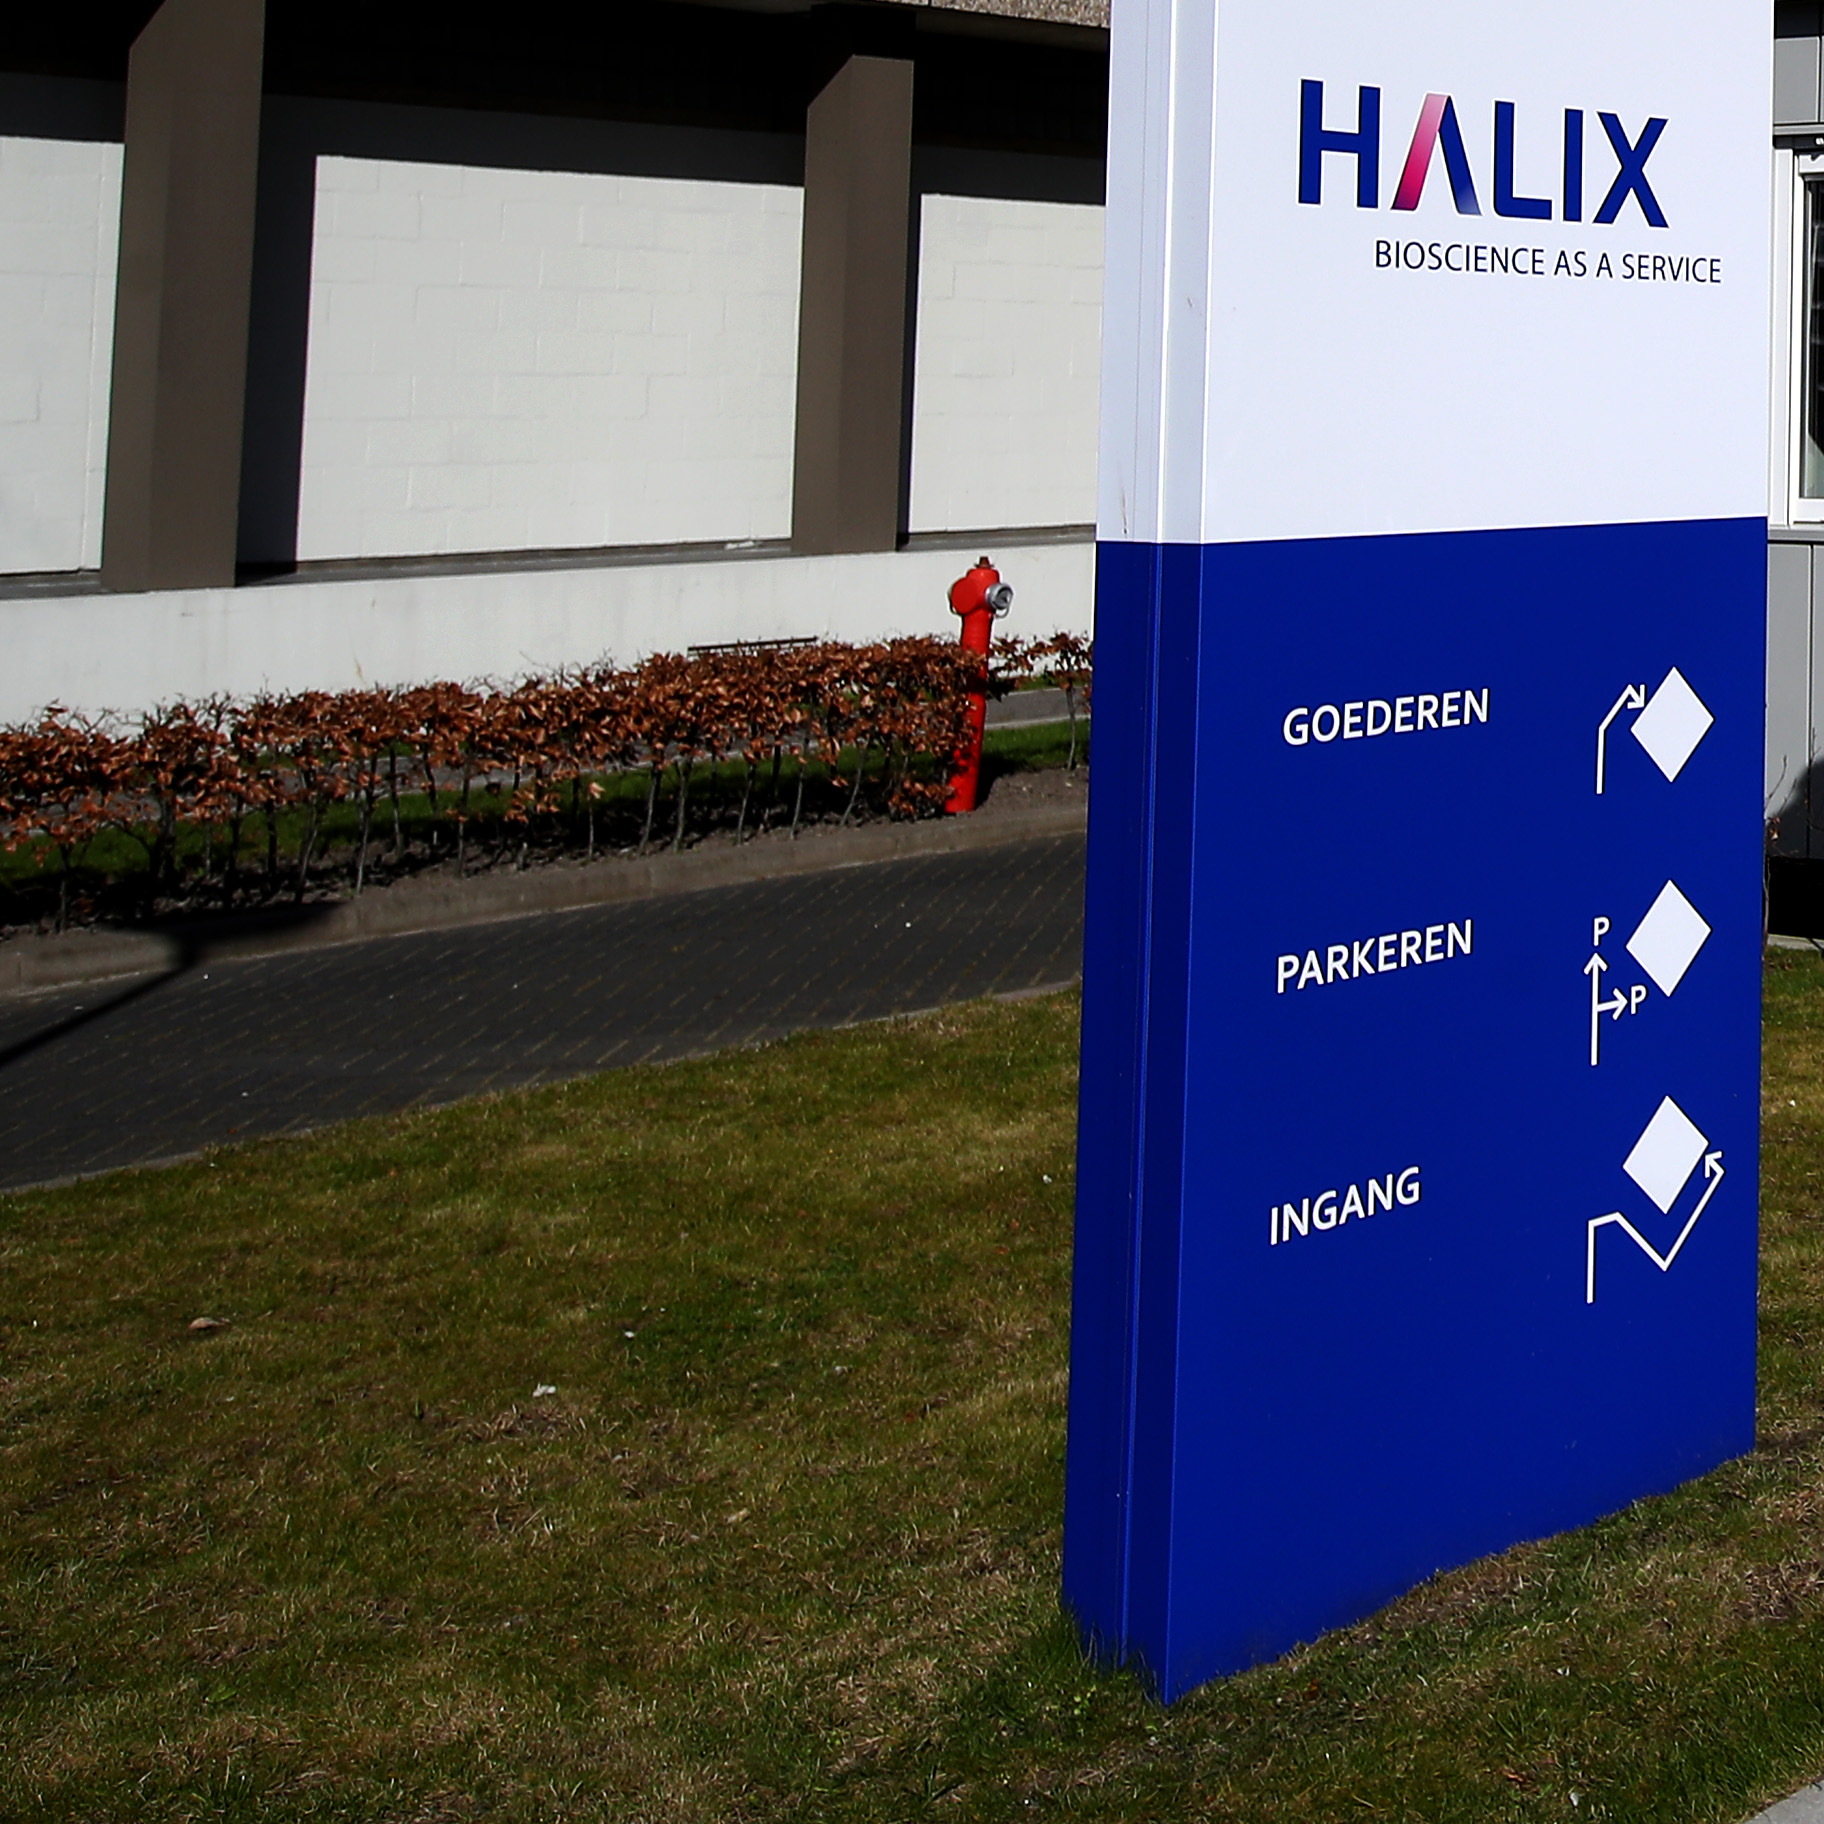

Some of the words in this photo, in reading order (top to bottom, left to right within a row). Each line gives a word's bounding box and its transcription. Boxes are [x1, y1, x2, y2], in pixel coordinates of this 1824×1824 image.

[1298, 78, 1669, 229] HALIX
[1375, 239, 1545, 276] BIOSCIENCE
[1553, 250, 1588, 278] AS
[1595, 252, 1613, 279] A
[1622, 253, 1722, 284] SERVICE
[1283, 688, 1489, 746] GOEDEREN
[1277, 919, 1473, 994] PARKEREN
[1593, 916, 1610, 947] P
[1630, 984, 1647, 1015] P
[1270, 1166, 1421, 1246] INGANG
